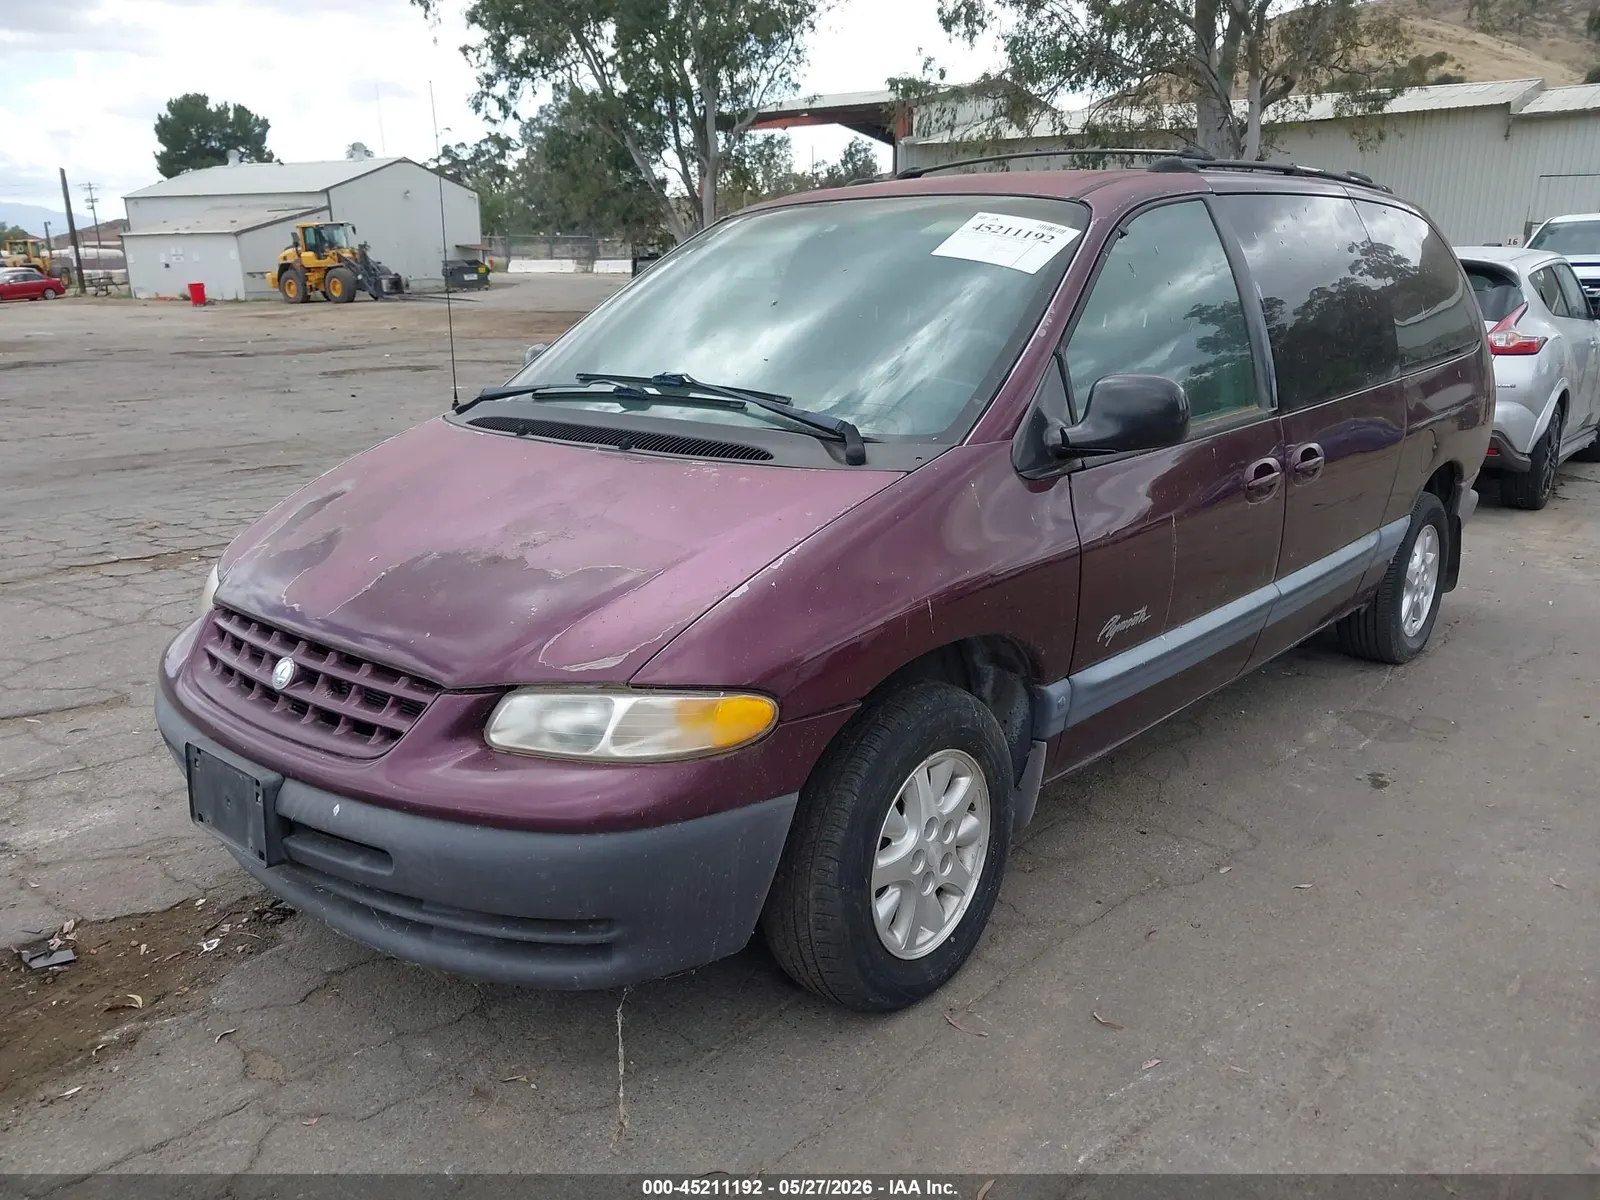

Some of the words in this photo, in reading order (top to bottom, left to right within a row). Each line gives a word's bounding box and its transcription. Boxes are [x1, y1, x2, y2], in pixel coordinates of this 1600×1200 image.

[972, 223, 1055, 244] 45211192
[1507, 238, 1518, 246] 16
[1097, 605, 1151, 647] Plymouth
